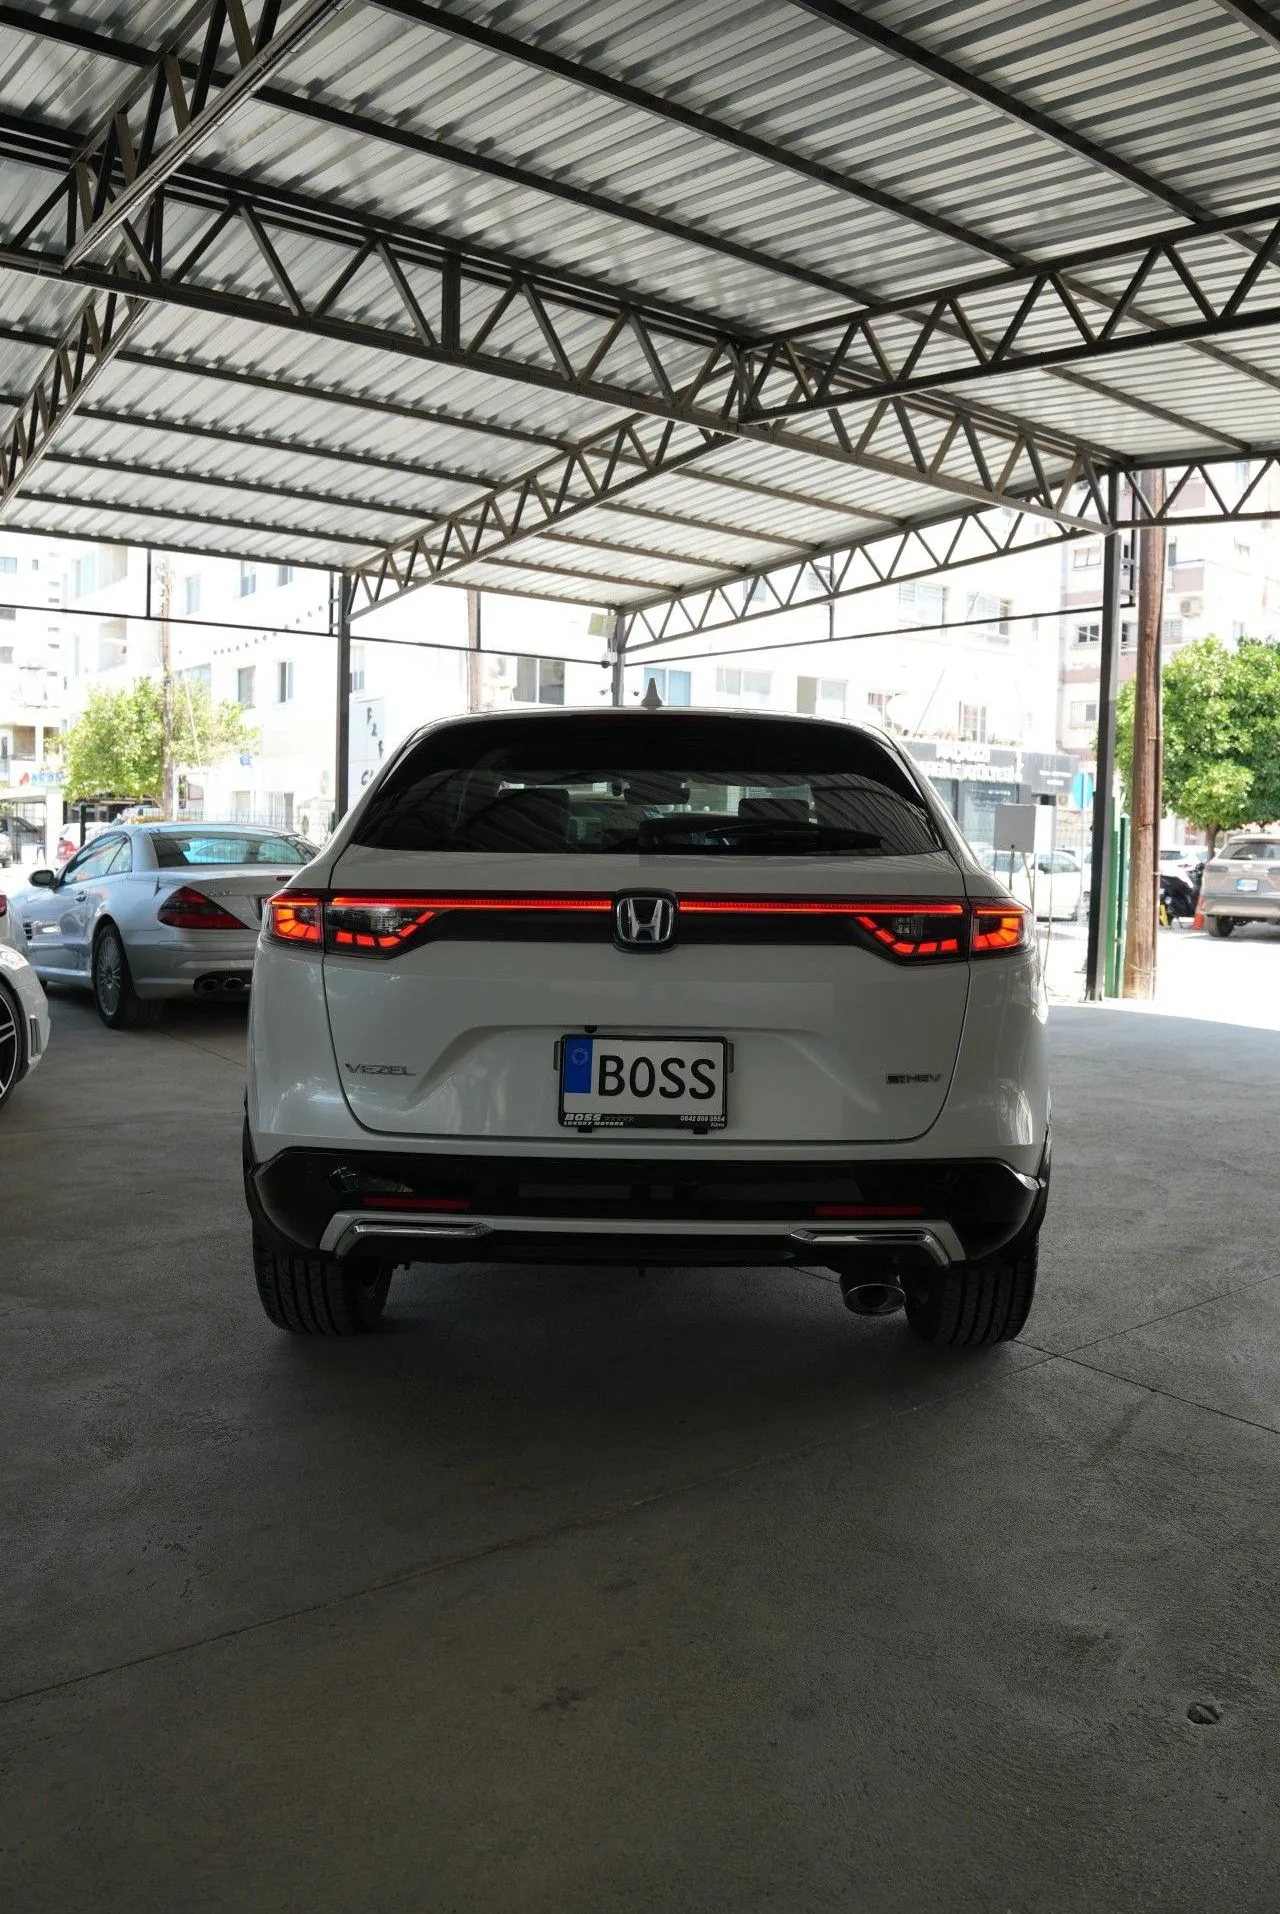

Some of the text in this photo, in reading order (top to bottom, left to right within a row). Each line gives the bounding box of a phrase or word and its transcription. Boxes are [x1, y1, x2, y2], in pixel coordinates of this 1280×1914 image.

[345, 1063, 416, 1076] VEZEL
[598, 1054, 716, 1100] BOSS
[564, 1113, 602, 1121] BOSS
